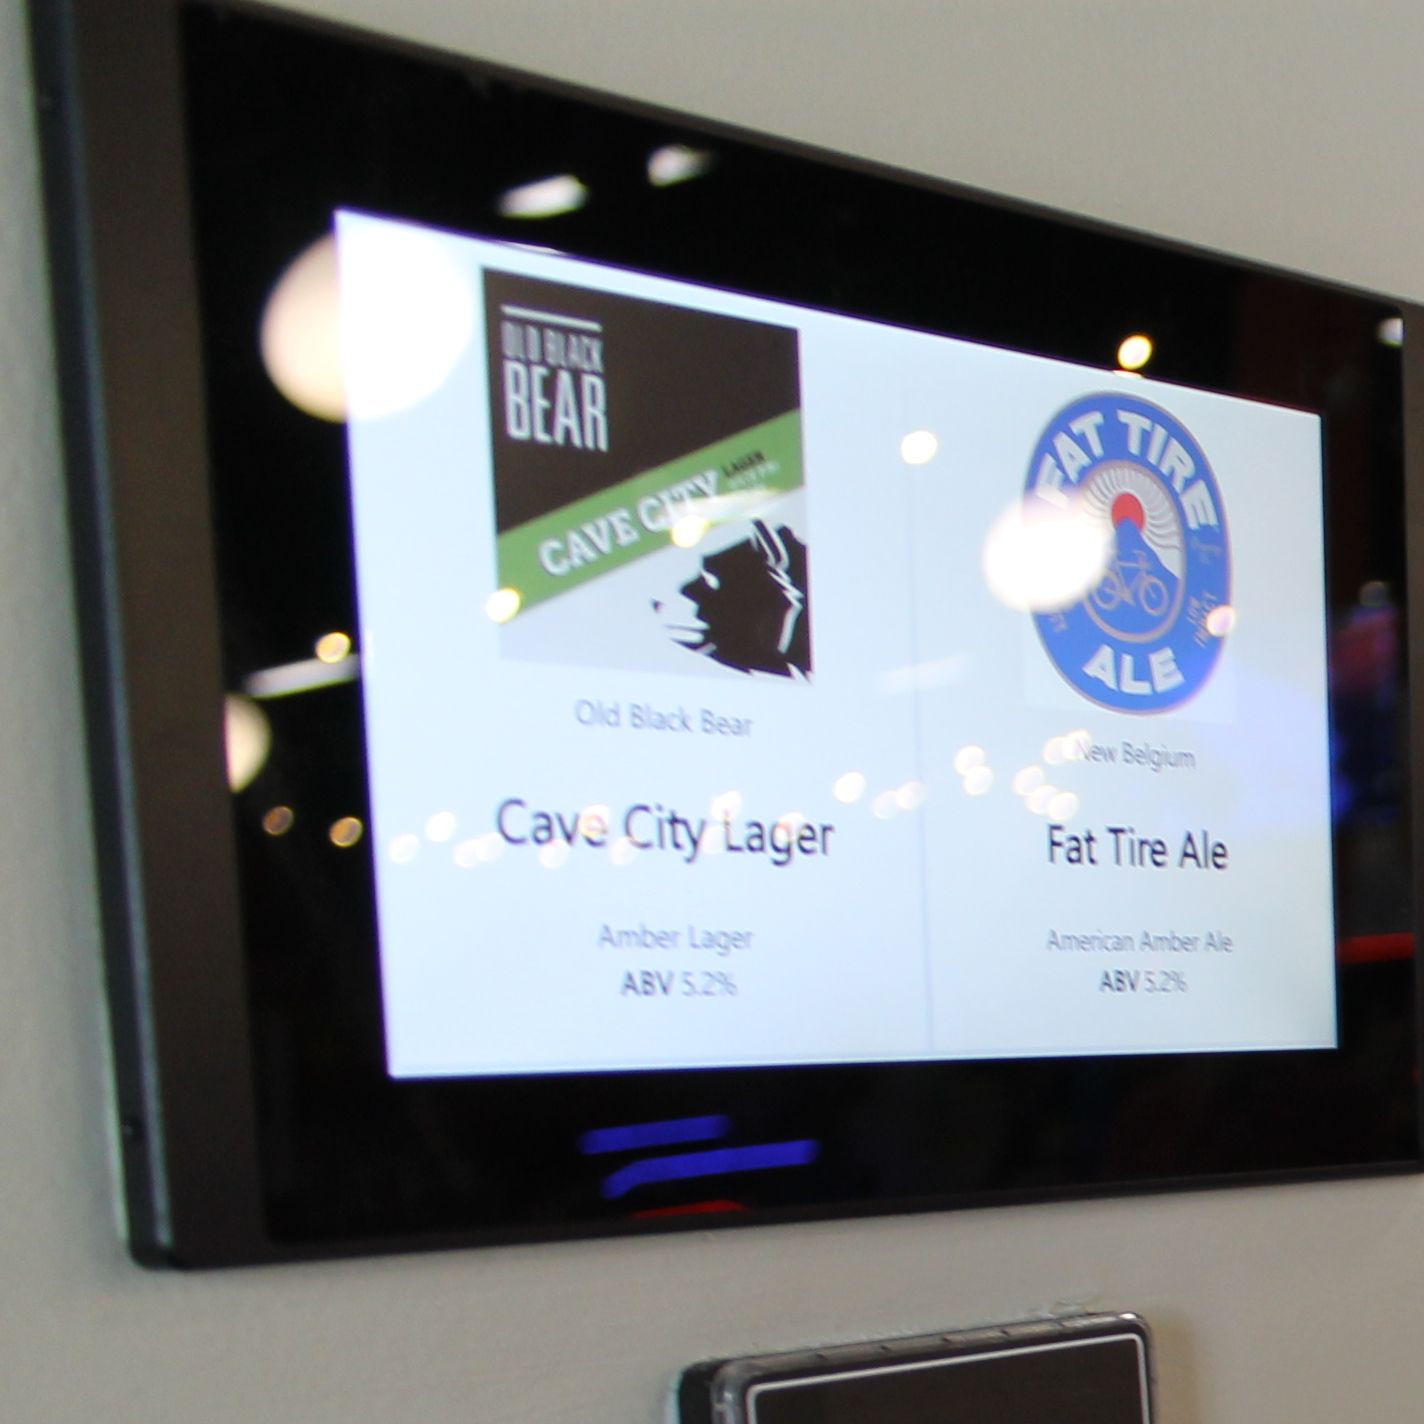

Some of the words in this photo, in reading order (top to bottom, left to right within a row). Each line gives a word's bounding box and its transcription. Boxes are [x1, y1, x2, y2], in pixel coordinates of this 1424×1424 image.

[503, 359, 609, 452] BEAR
[1034, 410, 1105, 511] FAT
[1116, 408, 1220, 532] TIRE
[538, 512, 640, 576] CAVE
[637, 468, 718, 535] CITY
[1082, 643, 1186, 696] ALE
[575, 700, 621, 729] Old
[630, 703, 692, 733] Black
[700, 708, 753, 738] Bear
[1122, 741, 1196, 773] Belgium
[496, 798, 609, 848] Cave
[624, 804, 707, 863] City
[723, 811, 835, 868] Lager
[1047, 824, 1098, 866] Fat
[1107, 827, 1168, 869] Tire
[1178, 830, 1230, 870] Ale
[597, 924, 681, 951] Amber
[688, 925, 754, 957] Lager
[1046, 929, 1136, 953] American
[1140, 931, 1200, 954] Amber
[1203, 932, 1235, 954] Ale
[620, 971, 675, 998] ABV
[680, 972, 739, 998] 5.2%
[1100, 970, 1142, 993] ABV
[1143, 972, 1188, 994] 5.2%
